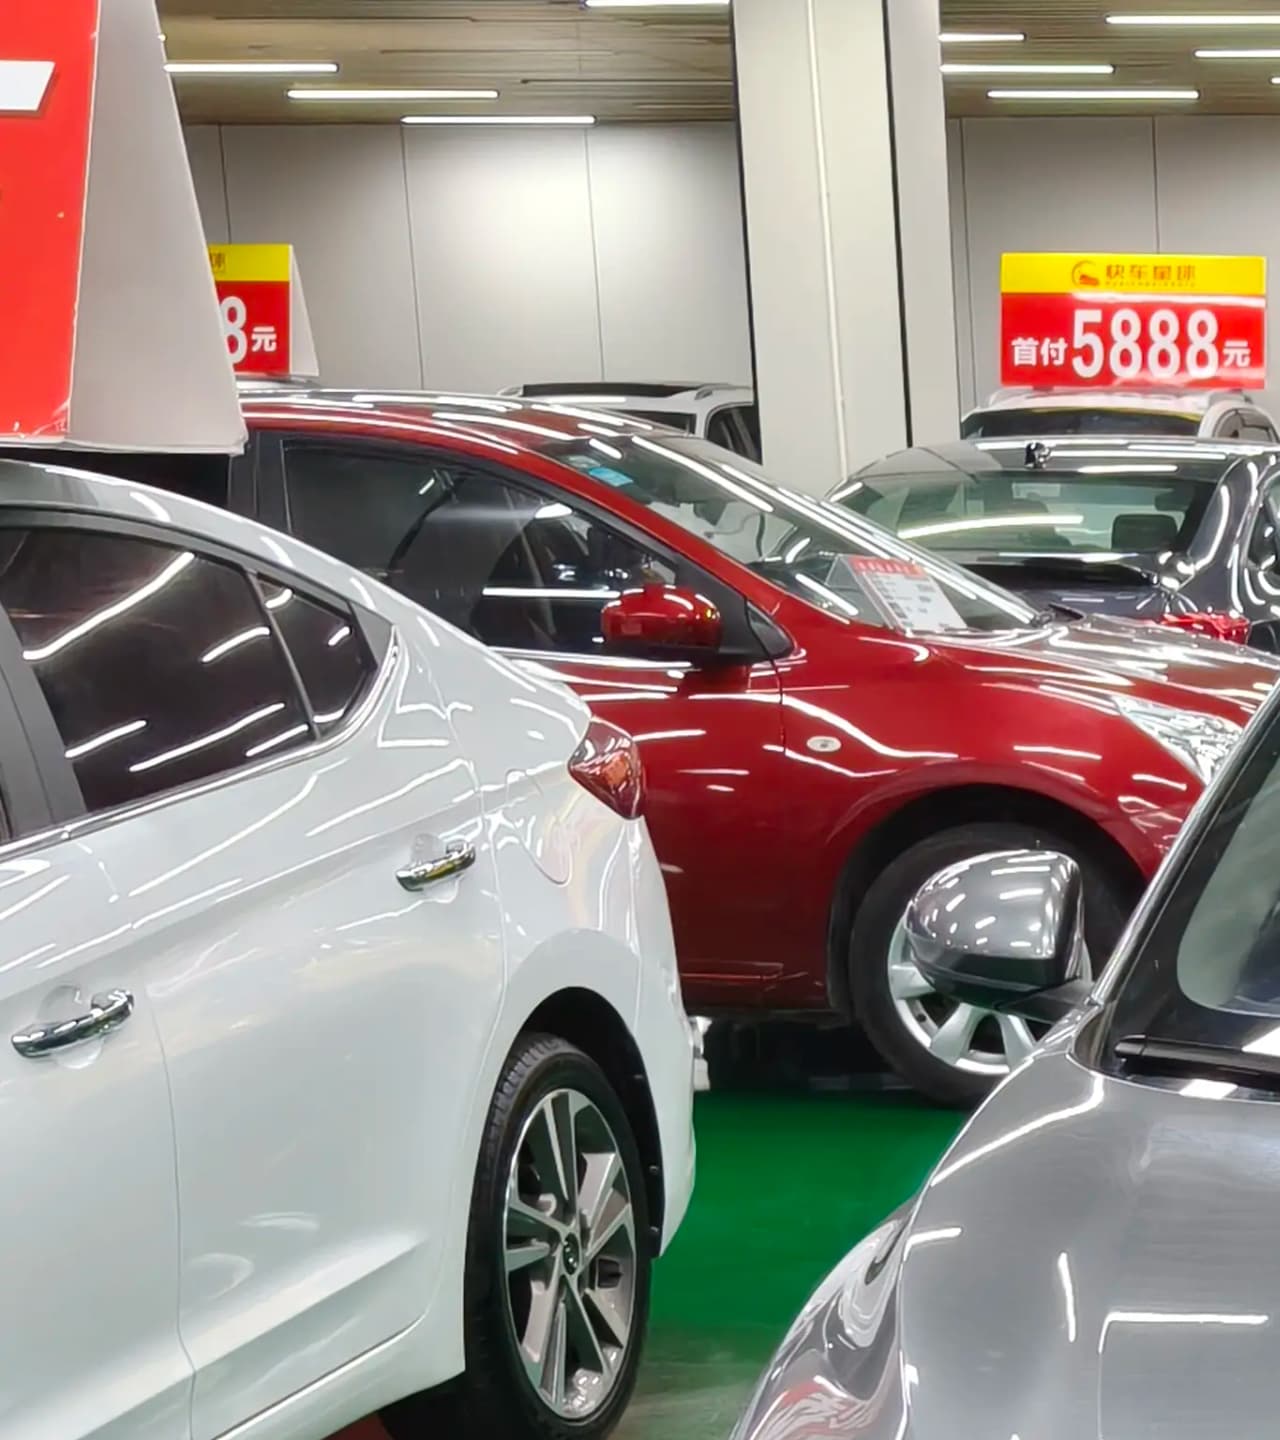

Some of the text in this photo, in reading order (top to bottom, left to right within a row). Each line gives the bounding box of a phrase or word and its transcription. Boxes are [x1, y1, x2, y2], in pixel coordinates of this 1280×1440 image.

[251, 326, 278, 352] 元
[1011, 308, 1251, 378] 首付 5888 元
